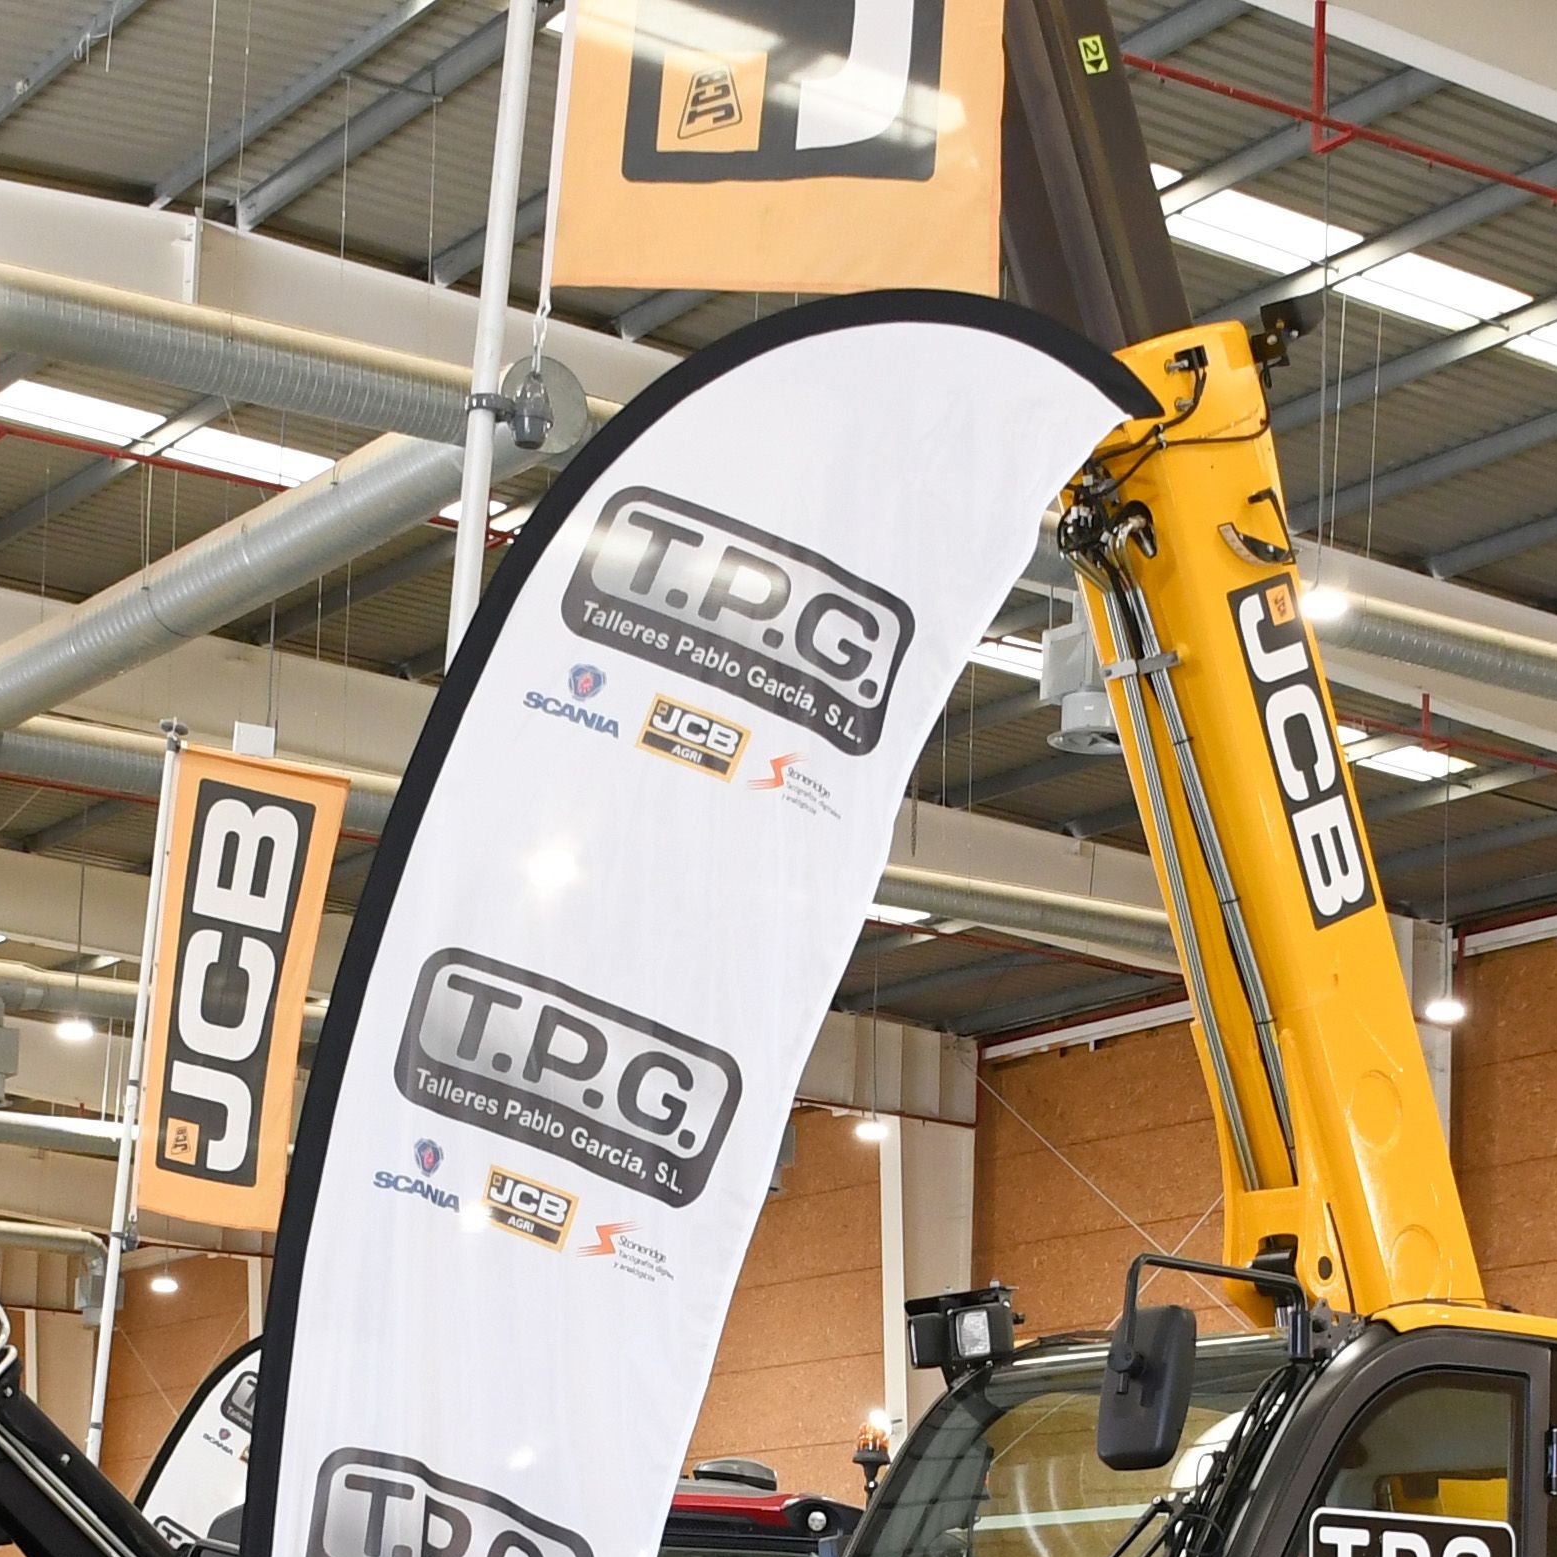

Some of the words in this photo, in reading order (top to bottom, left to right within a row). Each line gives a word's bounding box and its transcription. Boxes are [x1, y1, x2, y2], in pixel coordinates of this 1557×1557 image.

[624, 510, 880, 701] T.P.G.
[581, 599, 669, 652] Talleres
[675, 636, 742, 681] Pablo
[746, 664, 821, 719] García,
[824, 705, 863, 746] S.L.
[522, 690, 620, 740] SCANIA
[652, 702, 741, 758] JCB
[670, 743, 703, 765] AGRI
[1239, 592, 1365, 917] JCB
[170, 798, 299, 1173] JCB
[446, 973, 697, 1151] T.P.G.
[415, 1067, 500, 1116] Talleres
[503, 1100, 565, 1140] Pablo
[570, 1125, 647, 1180] García,
[654, 1161, 684, 1196] S.L.
[373, 1170, 461, 1214] SCANIA
[489, 1172, 570, 1225] JCB
[507, 1215, 535, 1233] AGRI
[203, 1432, 234, 1457] SCANIA
